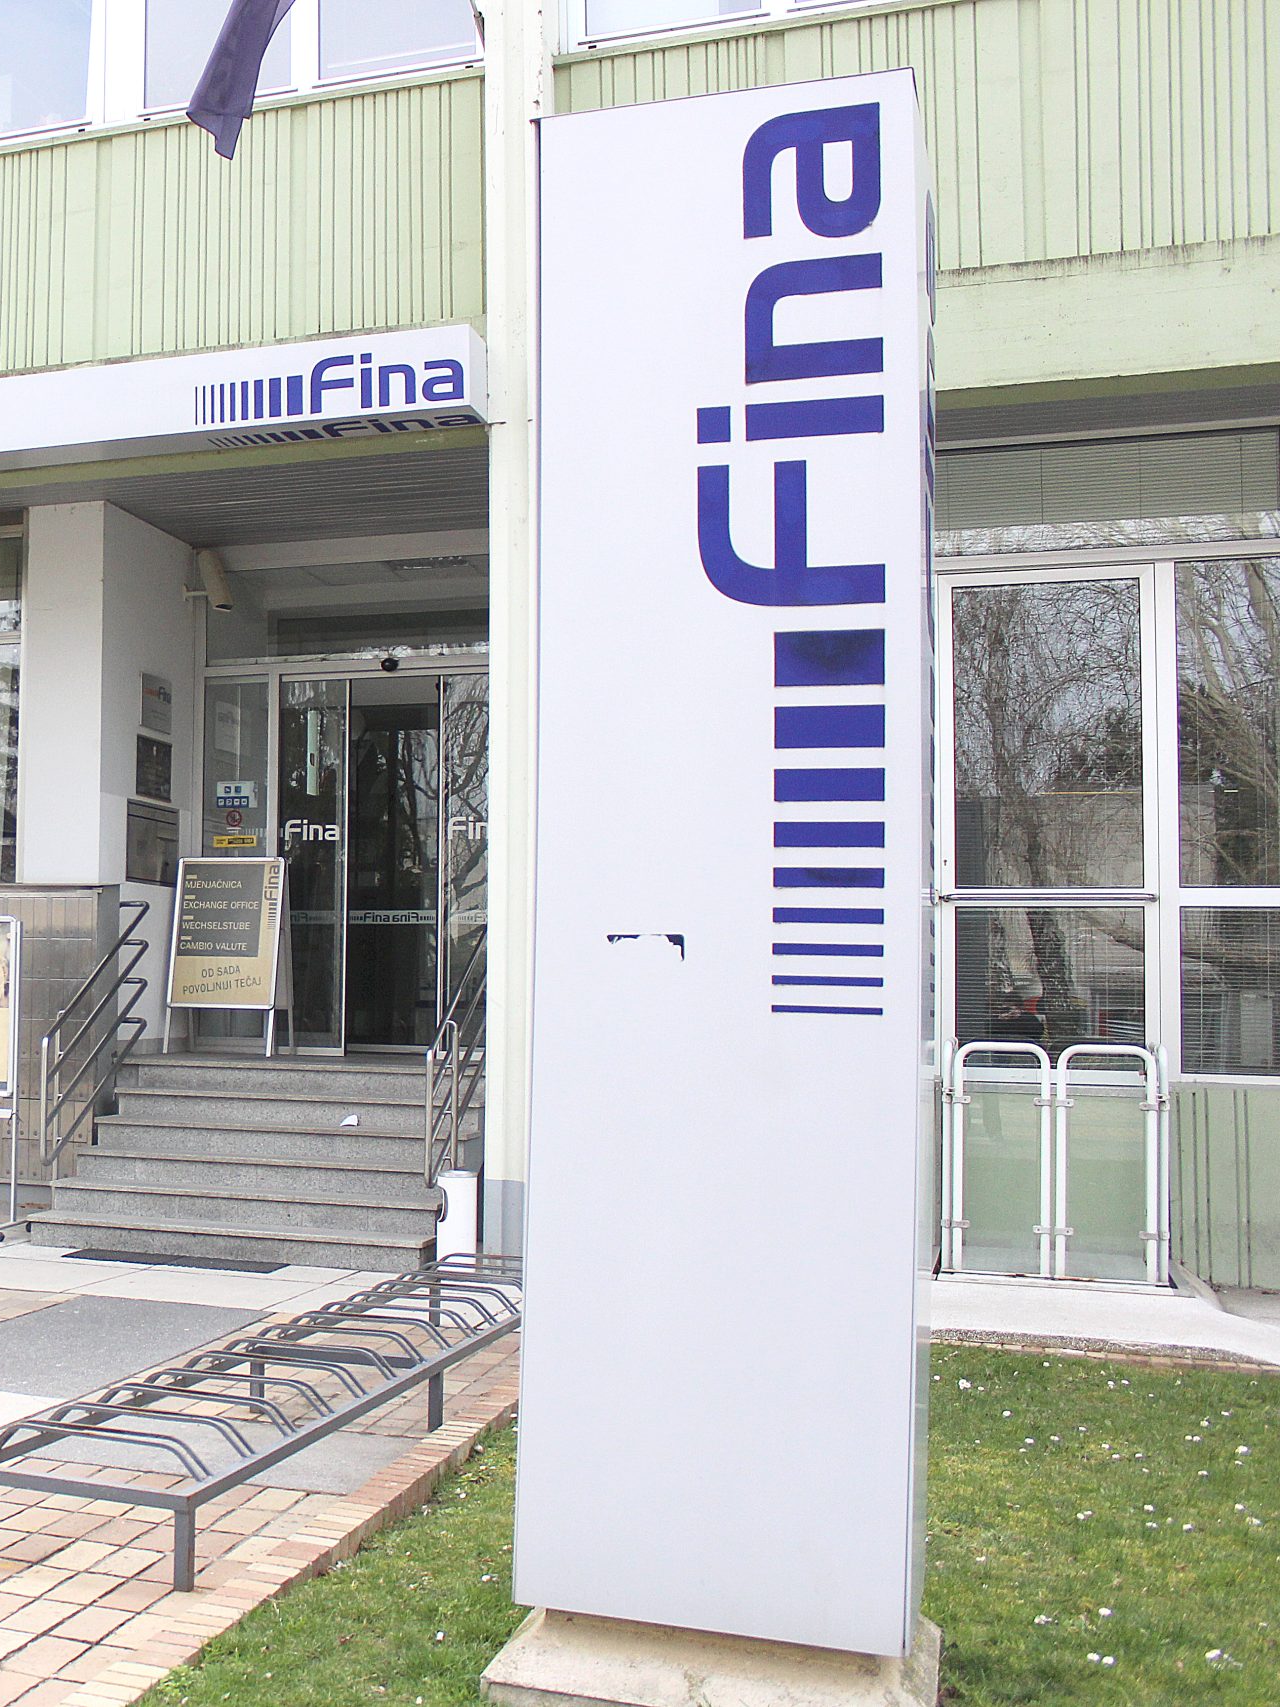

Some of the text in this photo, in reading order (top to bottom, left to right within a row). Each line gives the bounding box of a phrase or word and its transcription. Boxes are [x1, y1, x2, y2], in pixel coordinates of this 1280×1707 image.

[696, 101, 886, 607] Fina
[310, 352, 464, 415] Fina
[284, 819, 340, 841] Fina
[448, 816, 488, 840] Fin
[185, 879, 242, 889] MJENJAČNICA
[264, 865, 280, 901] Fina
[183, 901, 259, 909] EXCHANGE OFFICE
[364, 912, 390, 922] Fina
[182, 921, 251, 930] WECHSELSTUBE
[180, 941, 248, 951] CAMBIO VALUTE
[201, 965, 241, 978] OD SADA
[183, 975, 261, 995] POVOLJNIJI TEČAJ
